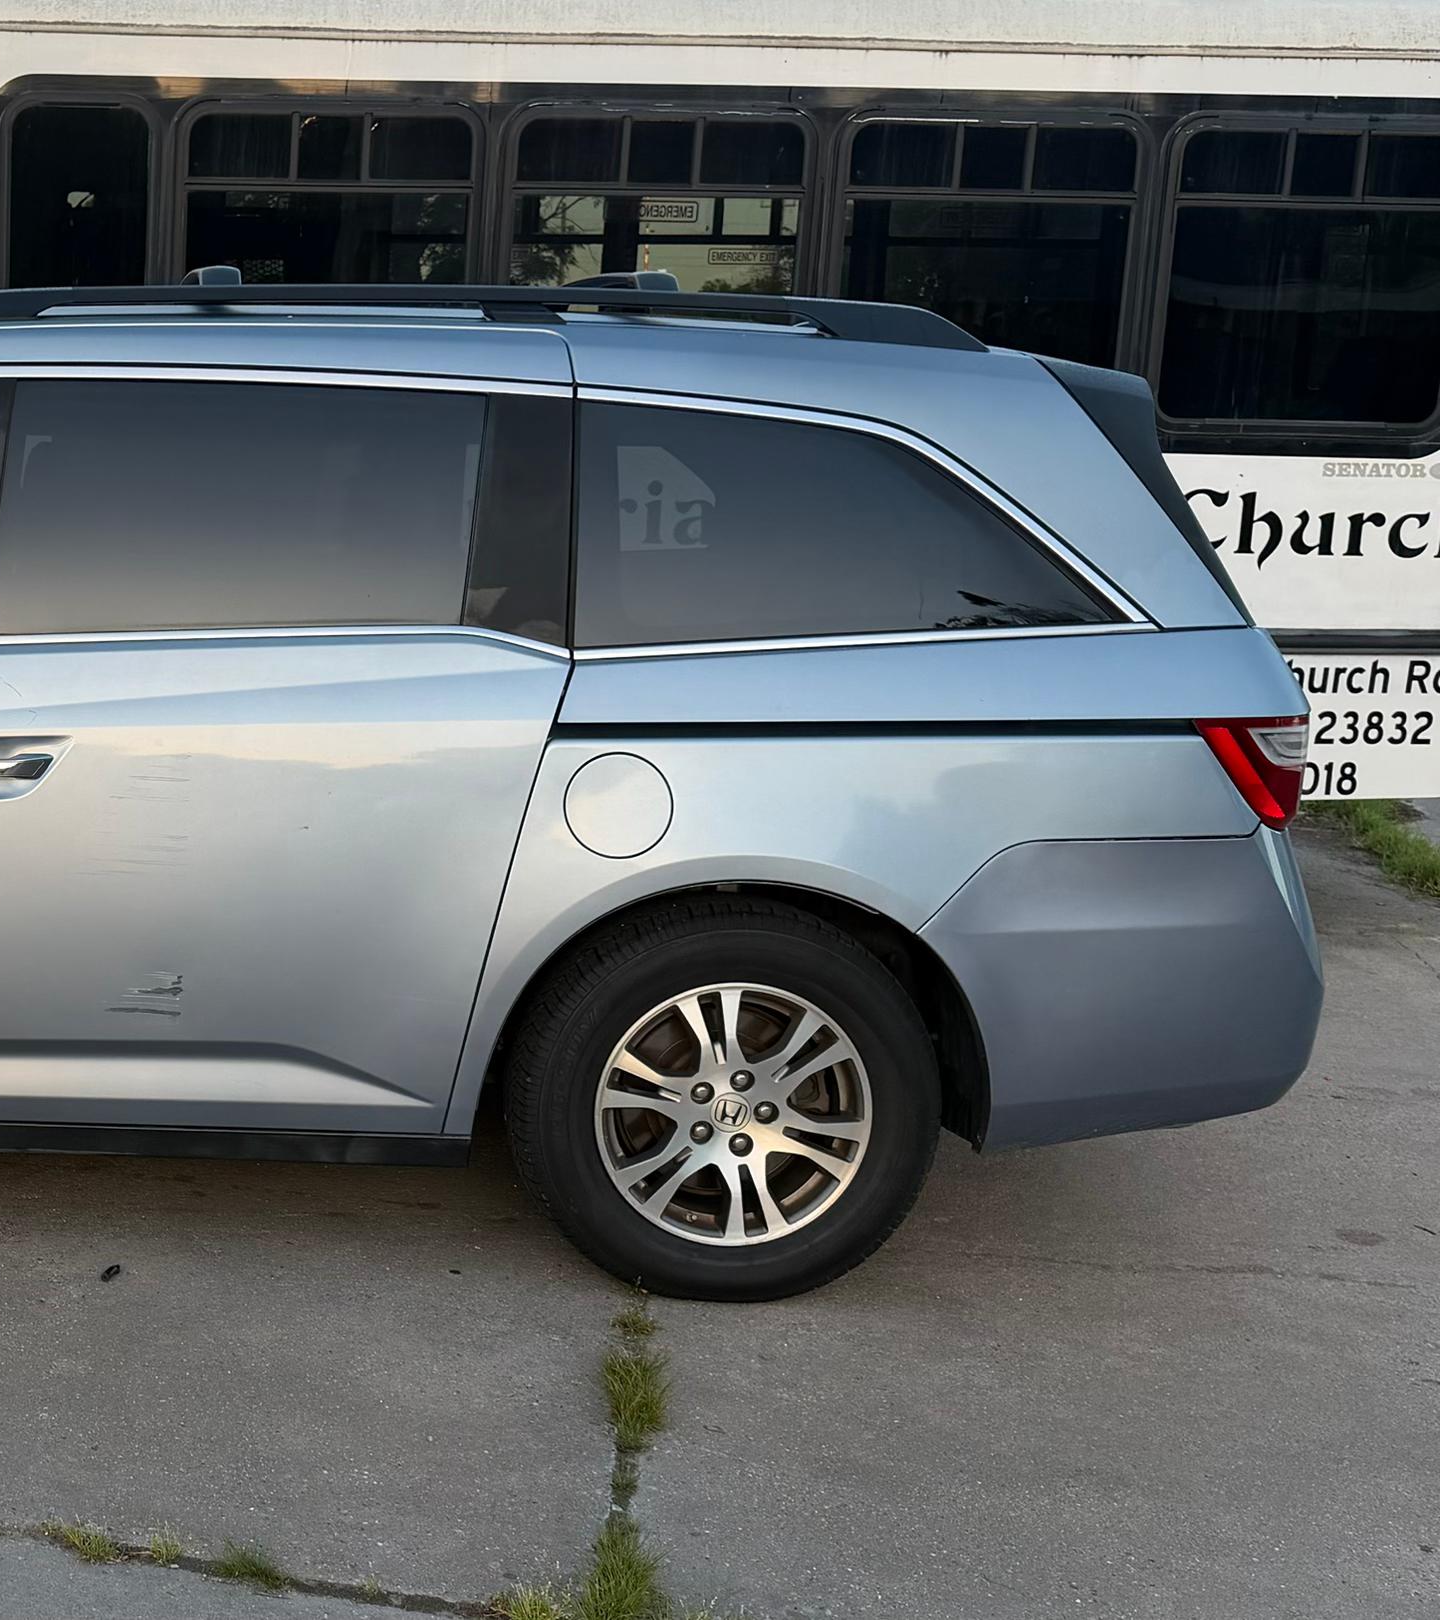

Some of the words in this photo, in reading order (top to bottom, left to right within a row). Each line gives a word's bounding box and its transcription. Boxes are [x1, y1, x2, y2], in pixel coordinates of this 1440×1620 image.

[711, 252, 757, 262] EMERGENCY
[1321, 463, 1427, 478] SENATOR
[1184, 487, 1440, 571] Churc
[1314, 710, 1433, 745] 23832
